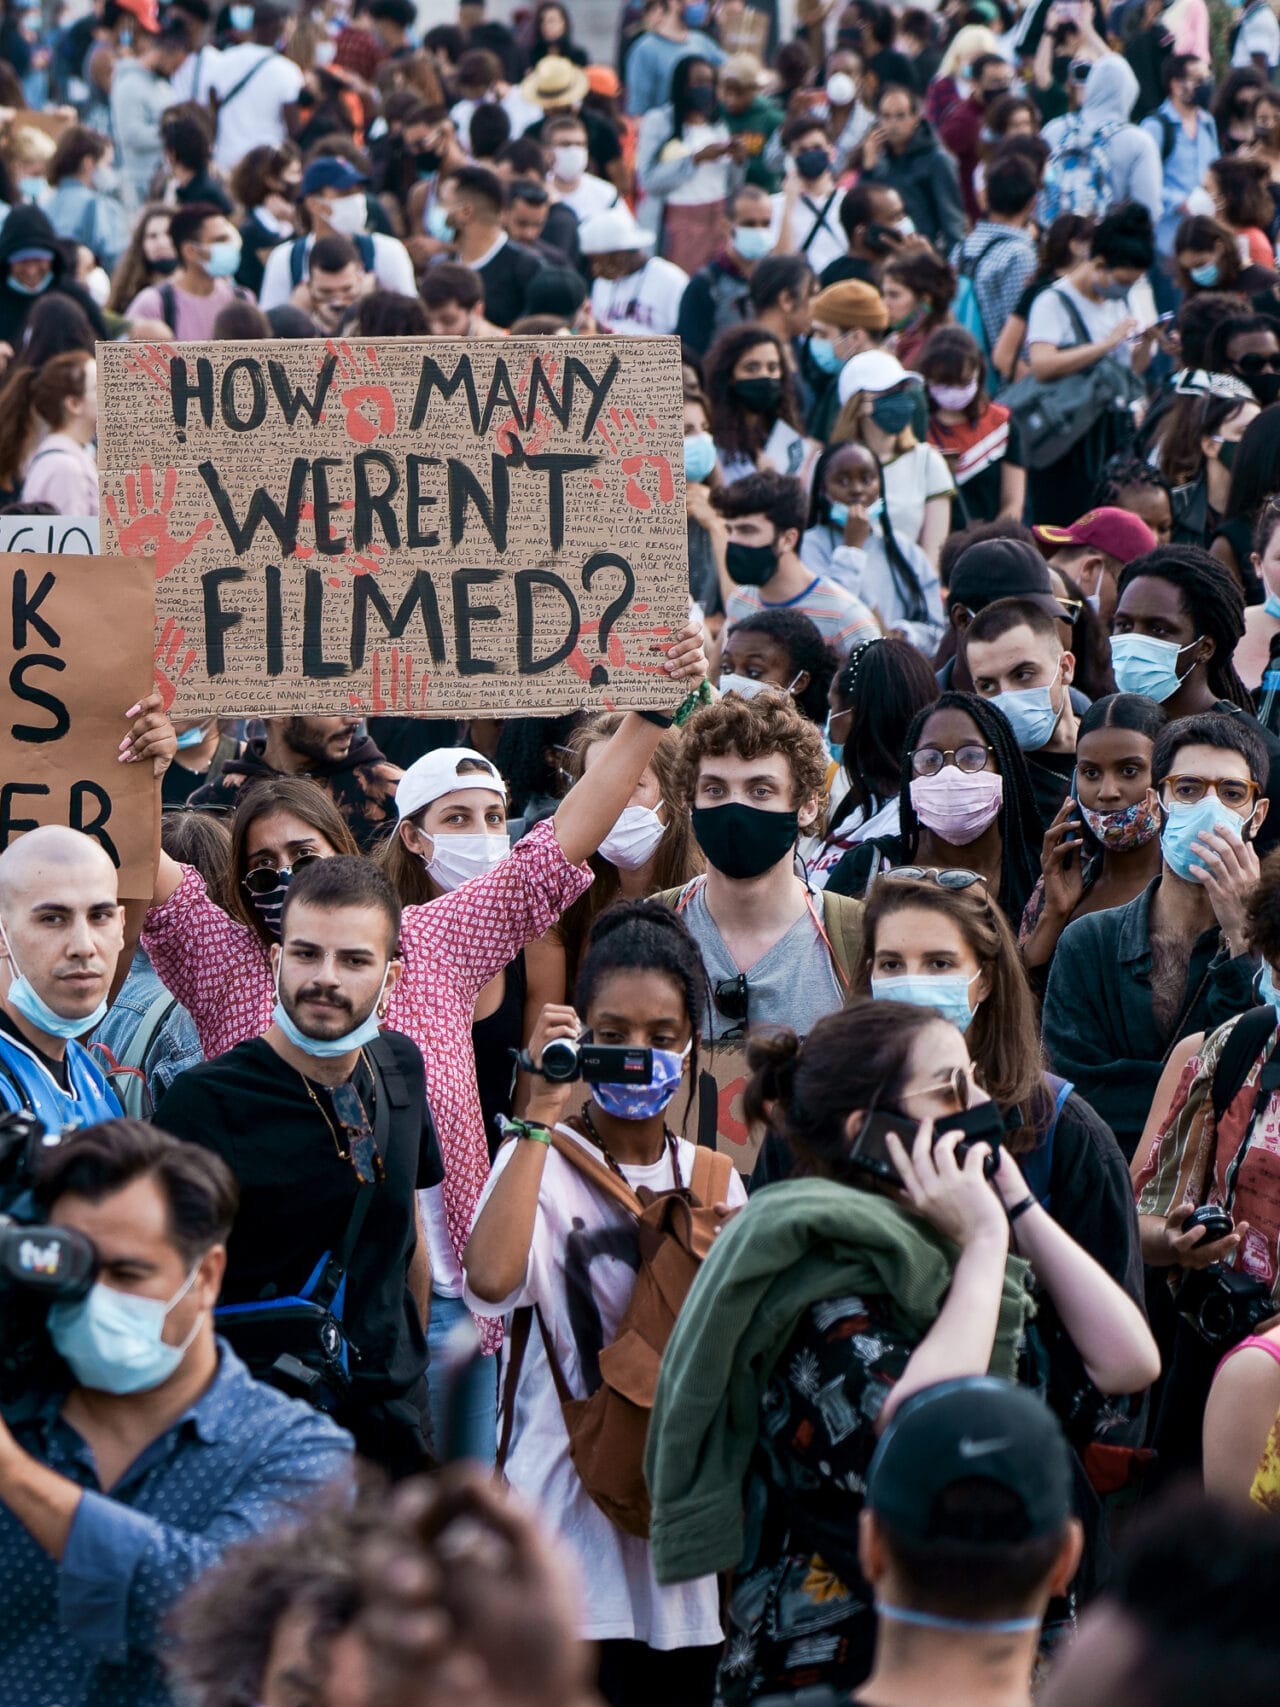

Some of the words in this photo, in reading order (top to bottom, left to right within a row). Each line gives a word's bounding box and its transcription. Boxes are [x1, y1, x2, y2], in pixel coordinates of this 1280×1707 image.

[170, 353, 338, 430] HOW
[410, 353, 621, 441] MANY
[201, 551, 636, 687] FILMED?
